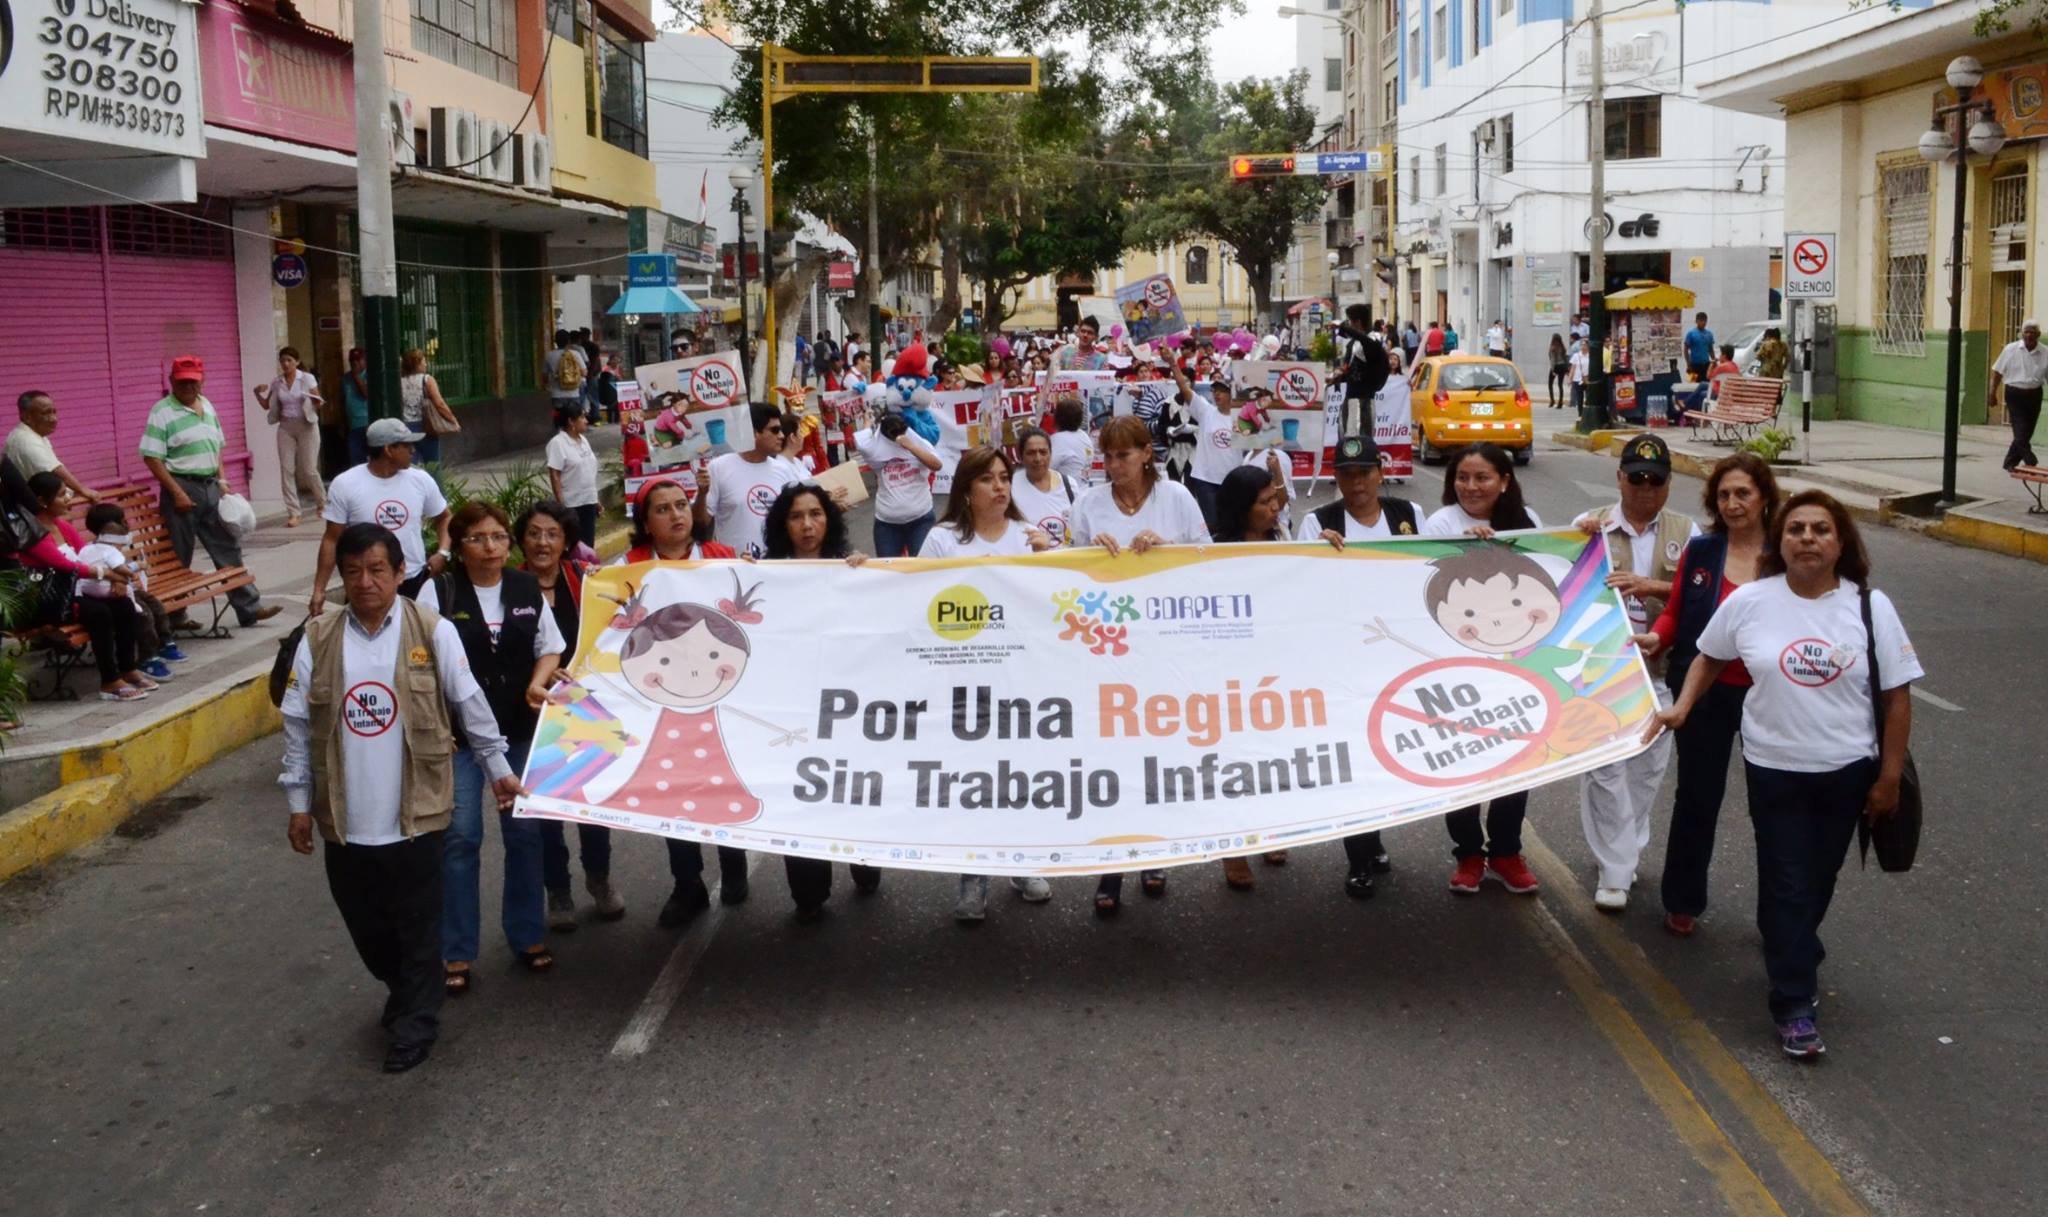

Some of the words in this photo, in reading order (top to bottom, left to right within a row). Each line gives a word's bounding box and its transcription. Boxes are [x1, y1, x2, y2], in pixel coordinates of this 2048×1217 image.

[87, 0, 177, 46] Delivery
[39, 16, 179, 75] 304750
[41, 53, 182, 106] 308300
[45, 87, 186, 138] RPM#539373
[277, 269, 303, 279] VISA
[1788, 280, 1832, 293] SILENCIO
[704, 369, 721, 381] No
[1290, 373, 1305, 385] No
[937, 600, 1005, 623] Piura
[1803, 644, 1823, 657] No
[359, 693, 378, 706] No
[817, 688, 928, 742] Por
[952, 685, 1074, 742] Una
[1098, 675, 1328, 747] Región
[1414, 683, 1482, 720] No
[1394, 728, 1425, 754] Al
[1428, 694, 1541, 741] Trabajo
[1422, 717, 1535, 772] Infantil
[793, 756, 884, 806] Sin
[907, 758, 1120, 820] Trabajo
[1144, 741, 1353, 805] Infantil
